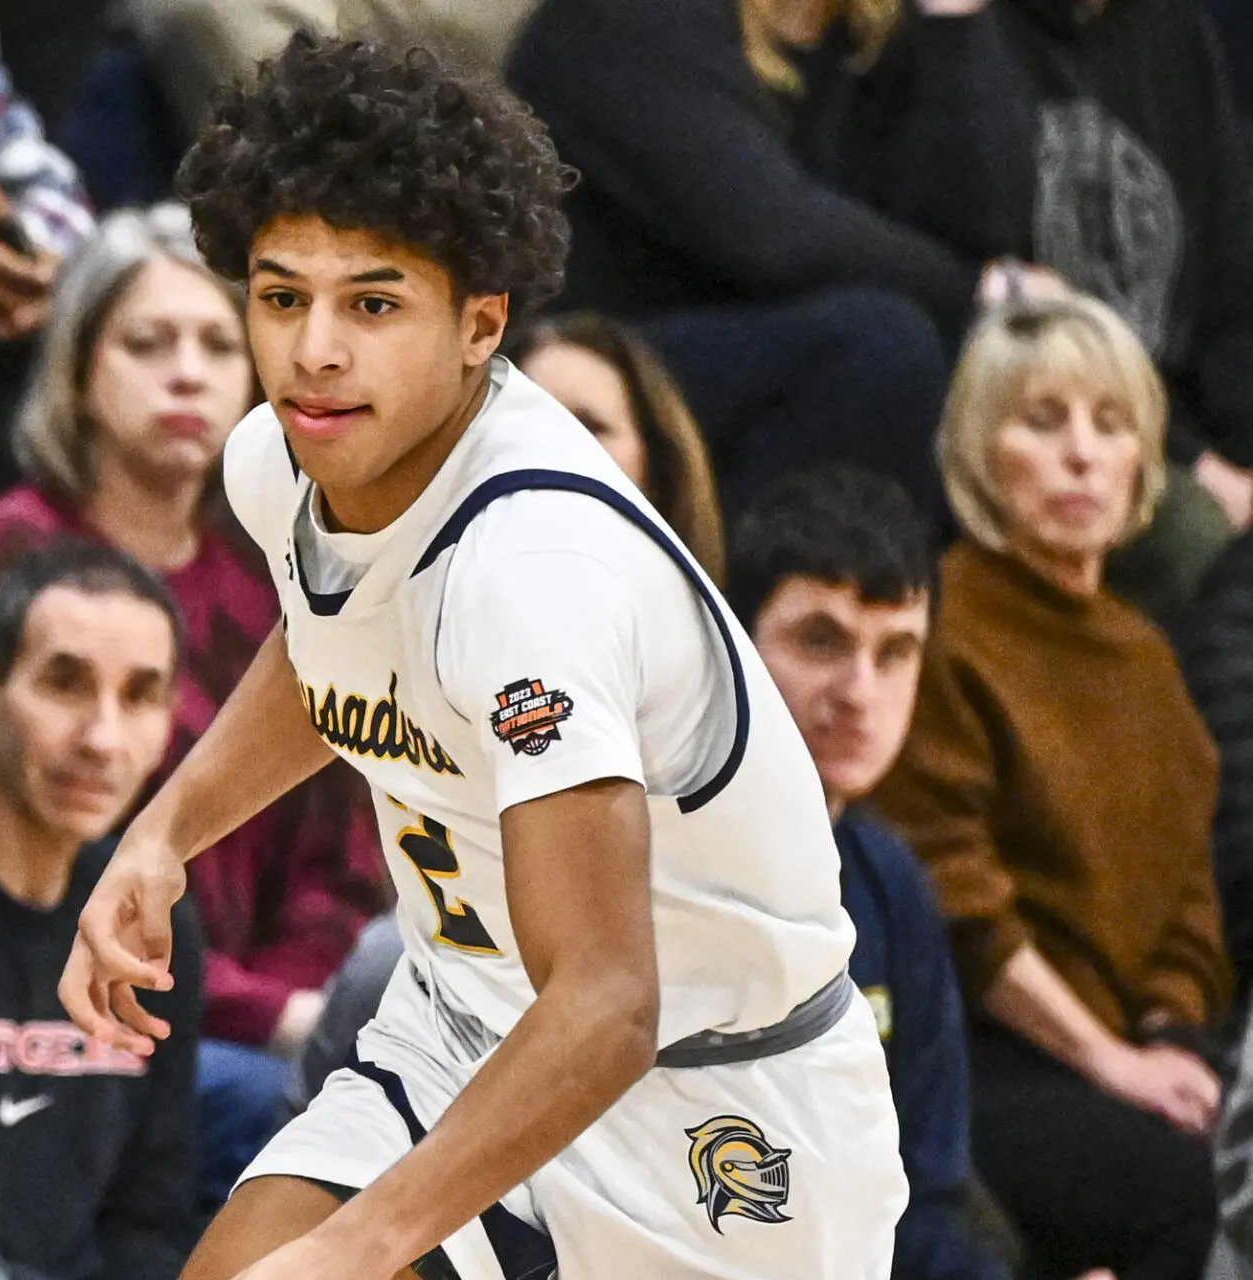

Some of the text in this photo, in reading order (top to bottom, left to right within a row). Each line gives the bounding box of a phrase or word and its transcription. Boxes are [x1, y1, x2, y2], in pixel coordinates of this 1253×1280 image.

[499, 694, 552, 721] EAST COAST
[508, 688, 531, 704] 2023
[384, 792, 503, 957] 2
